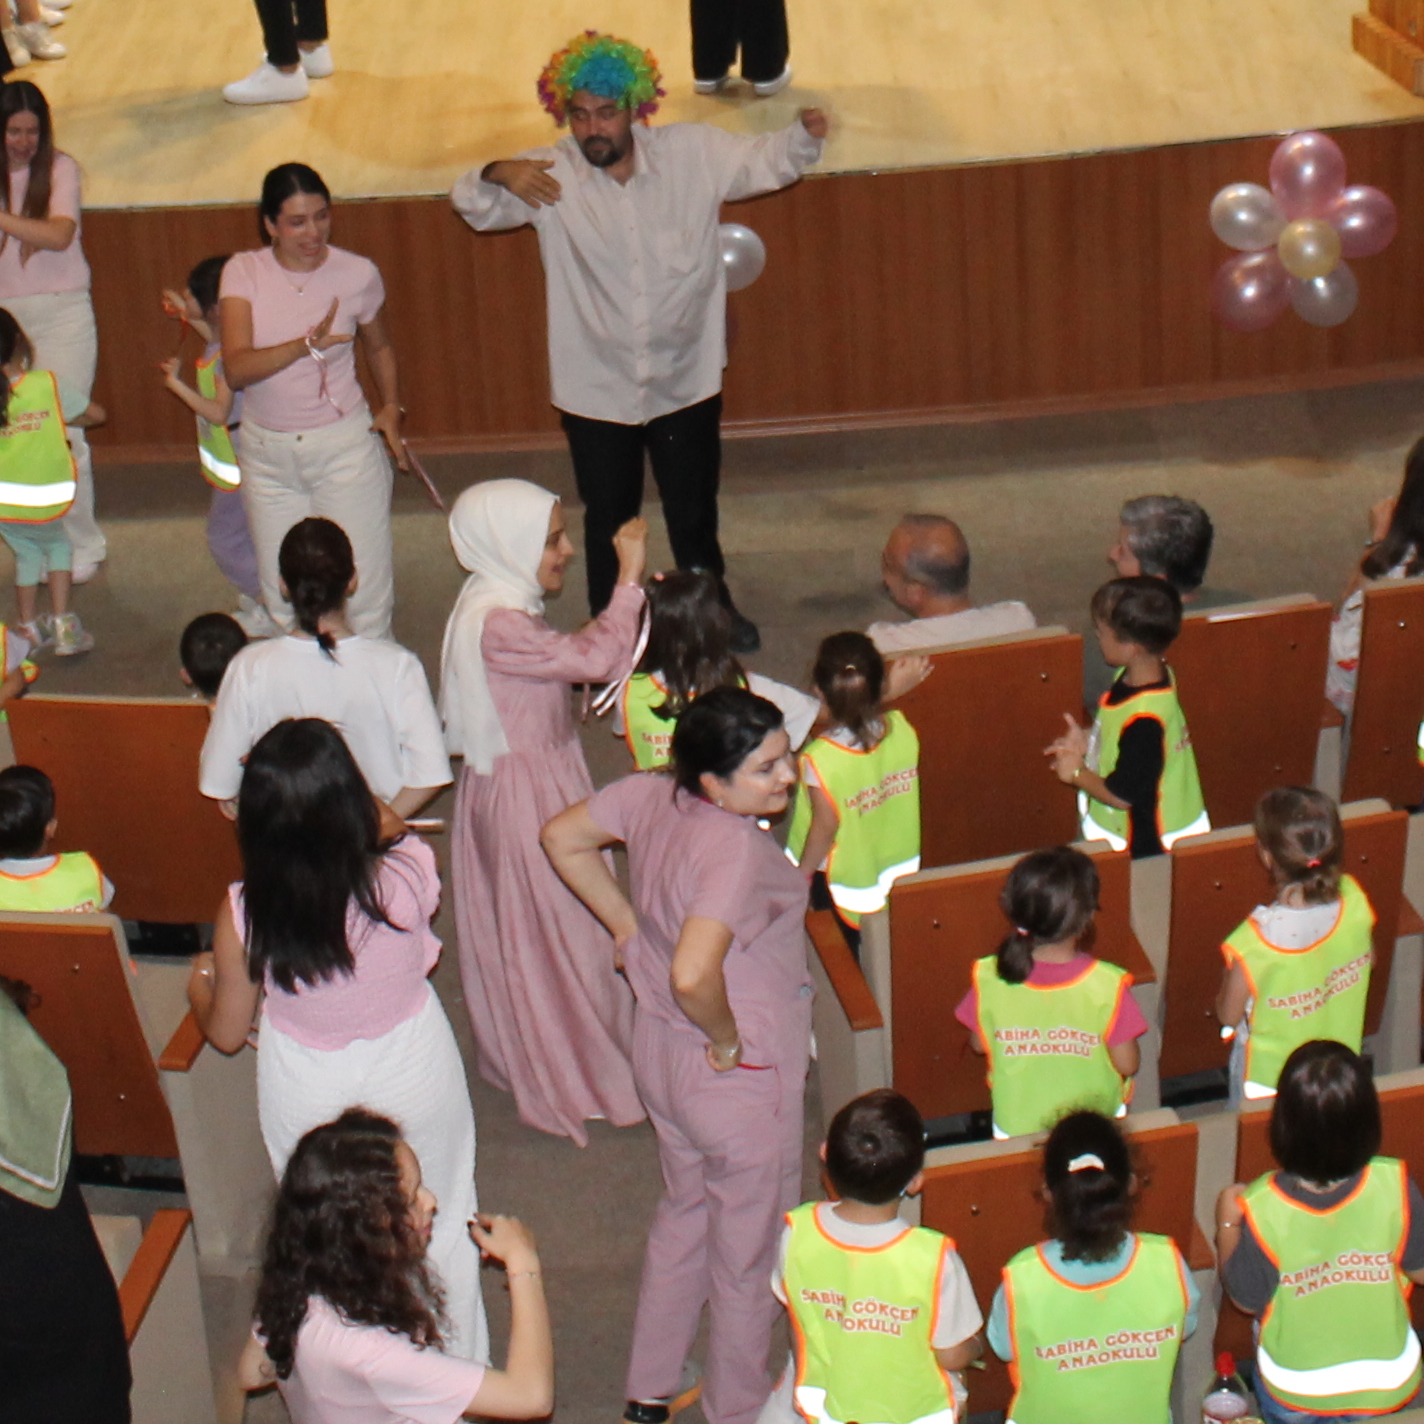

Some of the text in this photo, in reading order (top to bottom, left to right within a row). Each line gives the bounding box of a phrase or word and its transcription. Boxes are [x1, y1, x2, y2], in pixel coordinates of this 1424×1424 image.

[994, 1027, 1042, 1043] ABİHA
[1003, 1040, 1093, 1058] ANAOKULU
[1280, 1260, 1332, 1287] ABİHA
[1295, 1269, 1391, 1298] ANAOKULU
[800, 1289, 847, 1310] SABİH
[823, 1306, 903, 1337] ANOKULU
[1056, 1346, 1159, 1372] ANAOKULU
